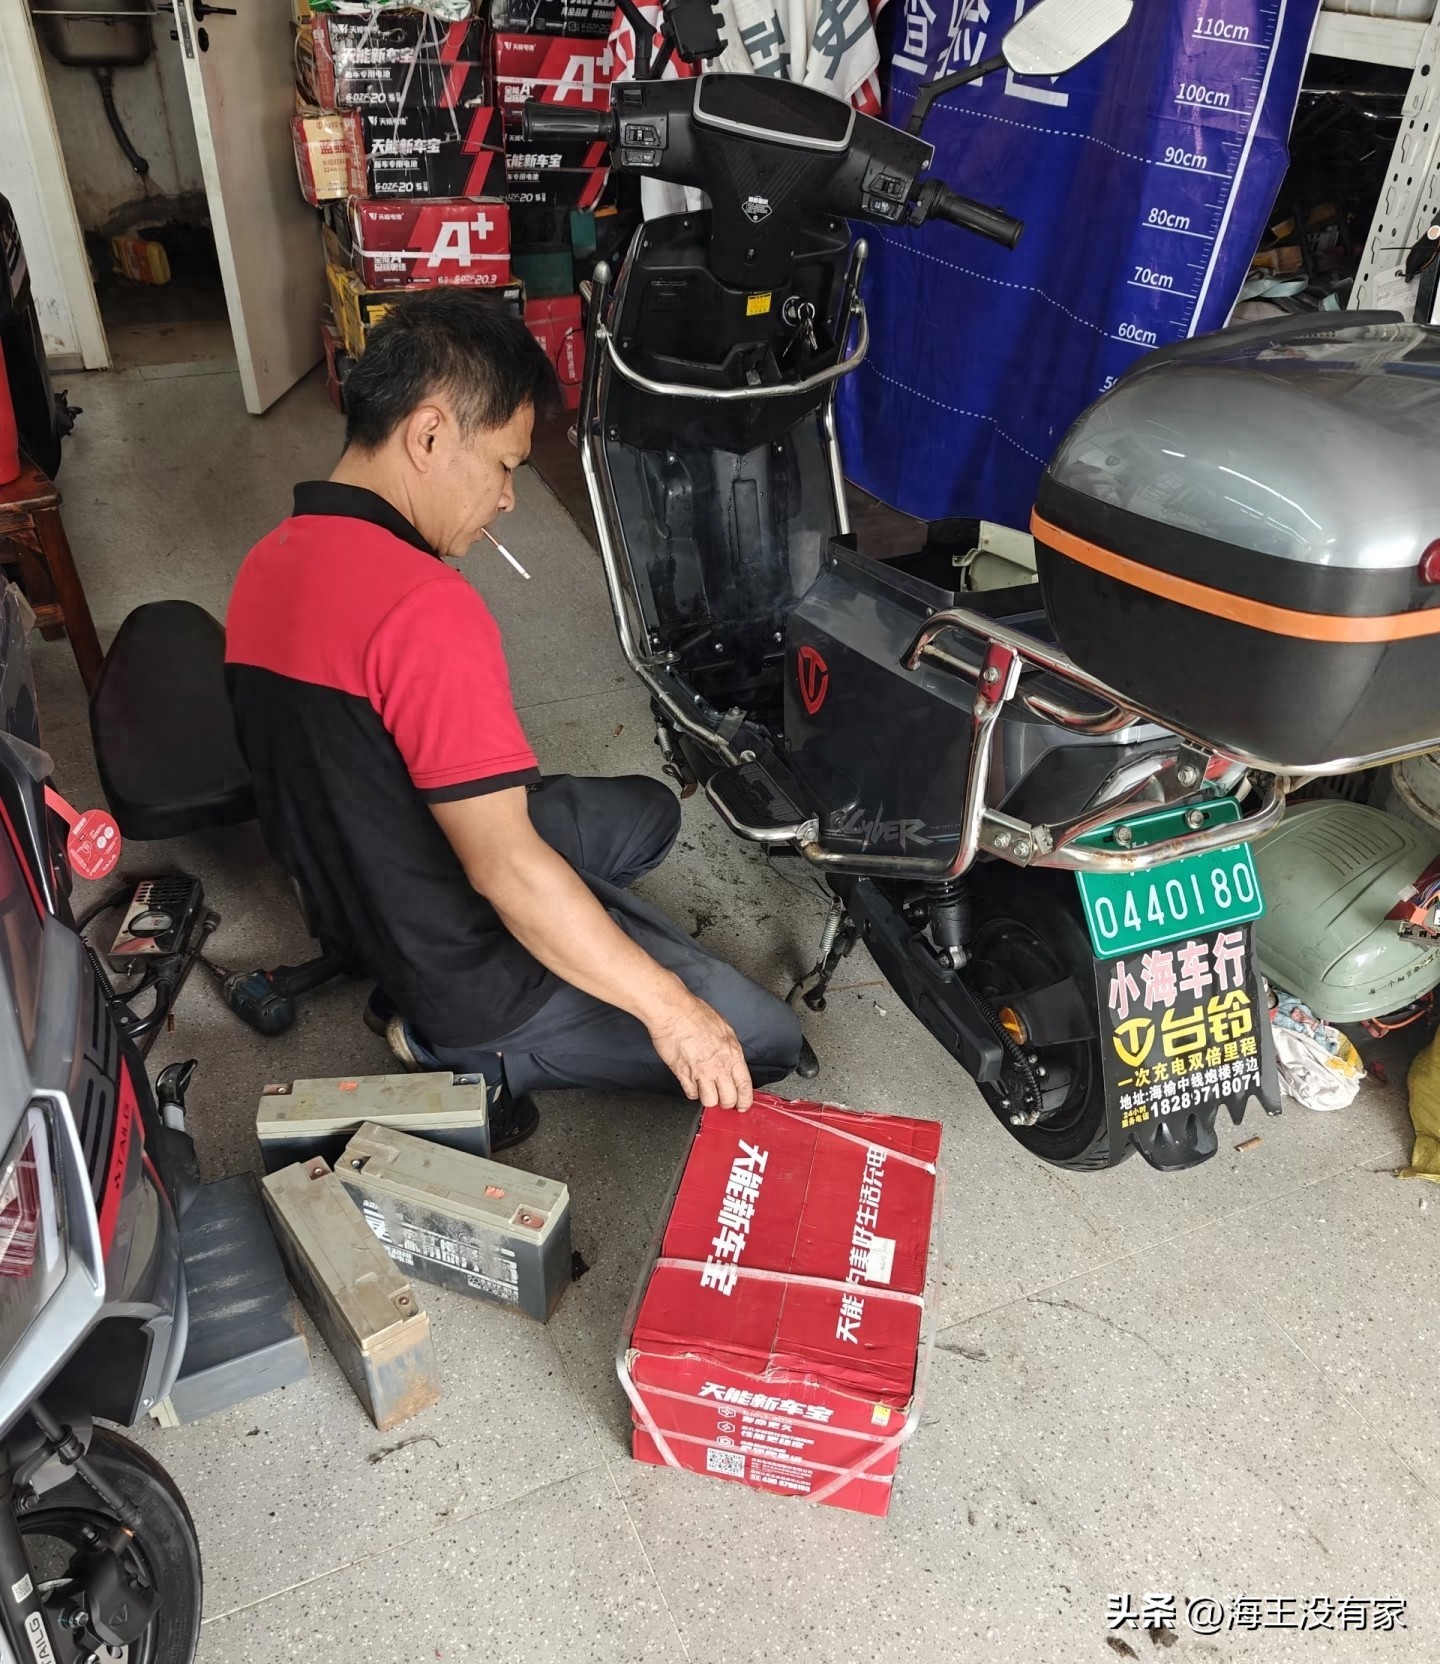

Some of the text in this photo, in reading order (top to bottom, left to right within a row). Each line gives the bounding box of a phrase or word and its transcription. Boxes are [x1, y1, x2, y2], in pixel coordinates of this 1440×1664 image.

[1193, 16, 1250, 41] 110cm
[553, 47, 614, 102] A+
[891, 0, 1070, 107] 查验
[1175, 82, 1230, 108] 100cm
[371, 138, 441, 155] 天能新车宝
[1163, 146, 1208, 170] 90cm
[375, 182, 414, 193] 6-DZF-20
[427, 212, 494, 268] A+
[1147, 207, 1191, 231] 80cm
[1133, 266, 1174, 289] 70cm
[1117, 322, 1158, 345] 60cm
[1094, 863, 1255, 939] 0440180
[1107, 930, 1246, 1020] 小海车行
[1160, 989, 1253, 1058] 台铃
[1117, 1035, 1258, 1088] 一次充电双倍里程
[1119, 1056, 1260, 1111] 地址:海榆中线炮楼旁边
[1122, 1104, 1147, 1118] 24小时
[1150, 1071, 1261, 1118] 18289718071
[700, 1138, 769, 1296] 天能新车宝
[697, 1381, 834, 1423] 天能新车宝
